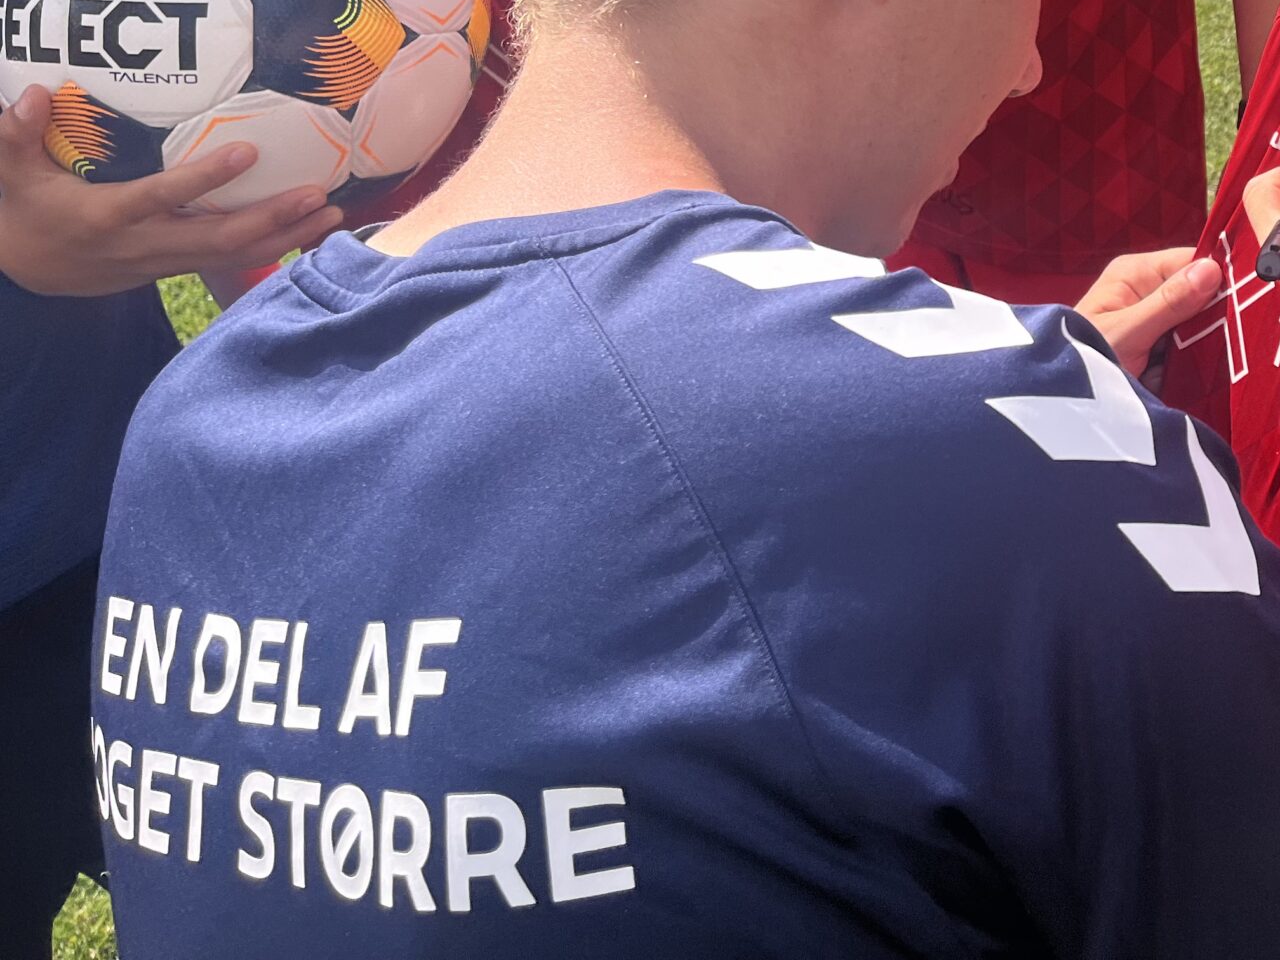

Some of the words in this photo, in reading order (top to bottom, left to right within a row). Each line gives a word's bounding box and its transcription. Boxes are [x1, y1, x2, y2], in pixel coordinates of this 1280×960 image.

[109, 71, 198, 85] TALENTO
[101, 596, 182, 704] EN
[190, 613, 320, 730] DEL
[338, 618, 462, 736] AF
[91, 716, 220, 862] OGET
[237, 770, 636, 912] STØRRE
